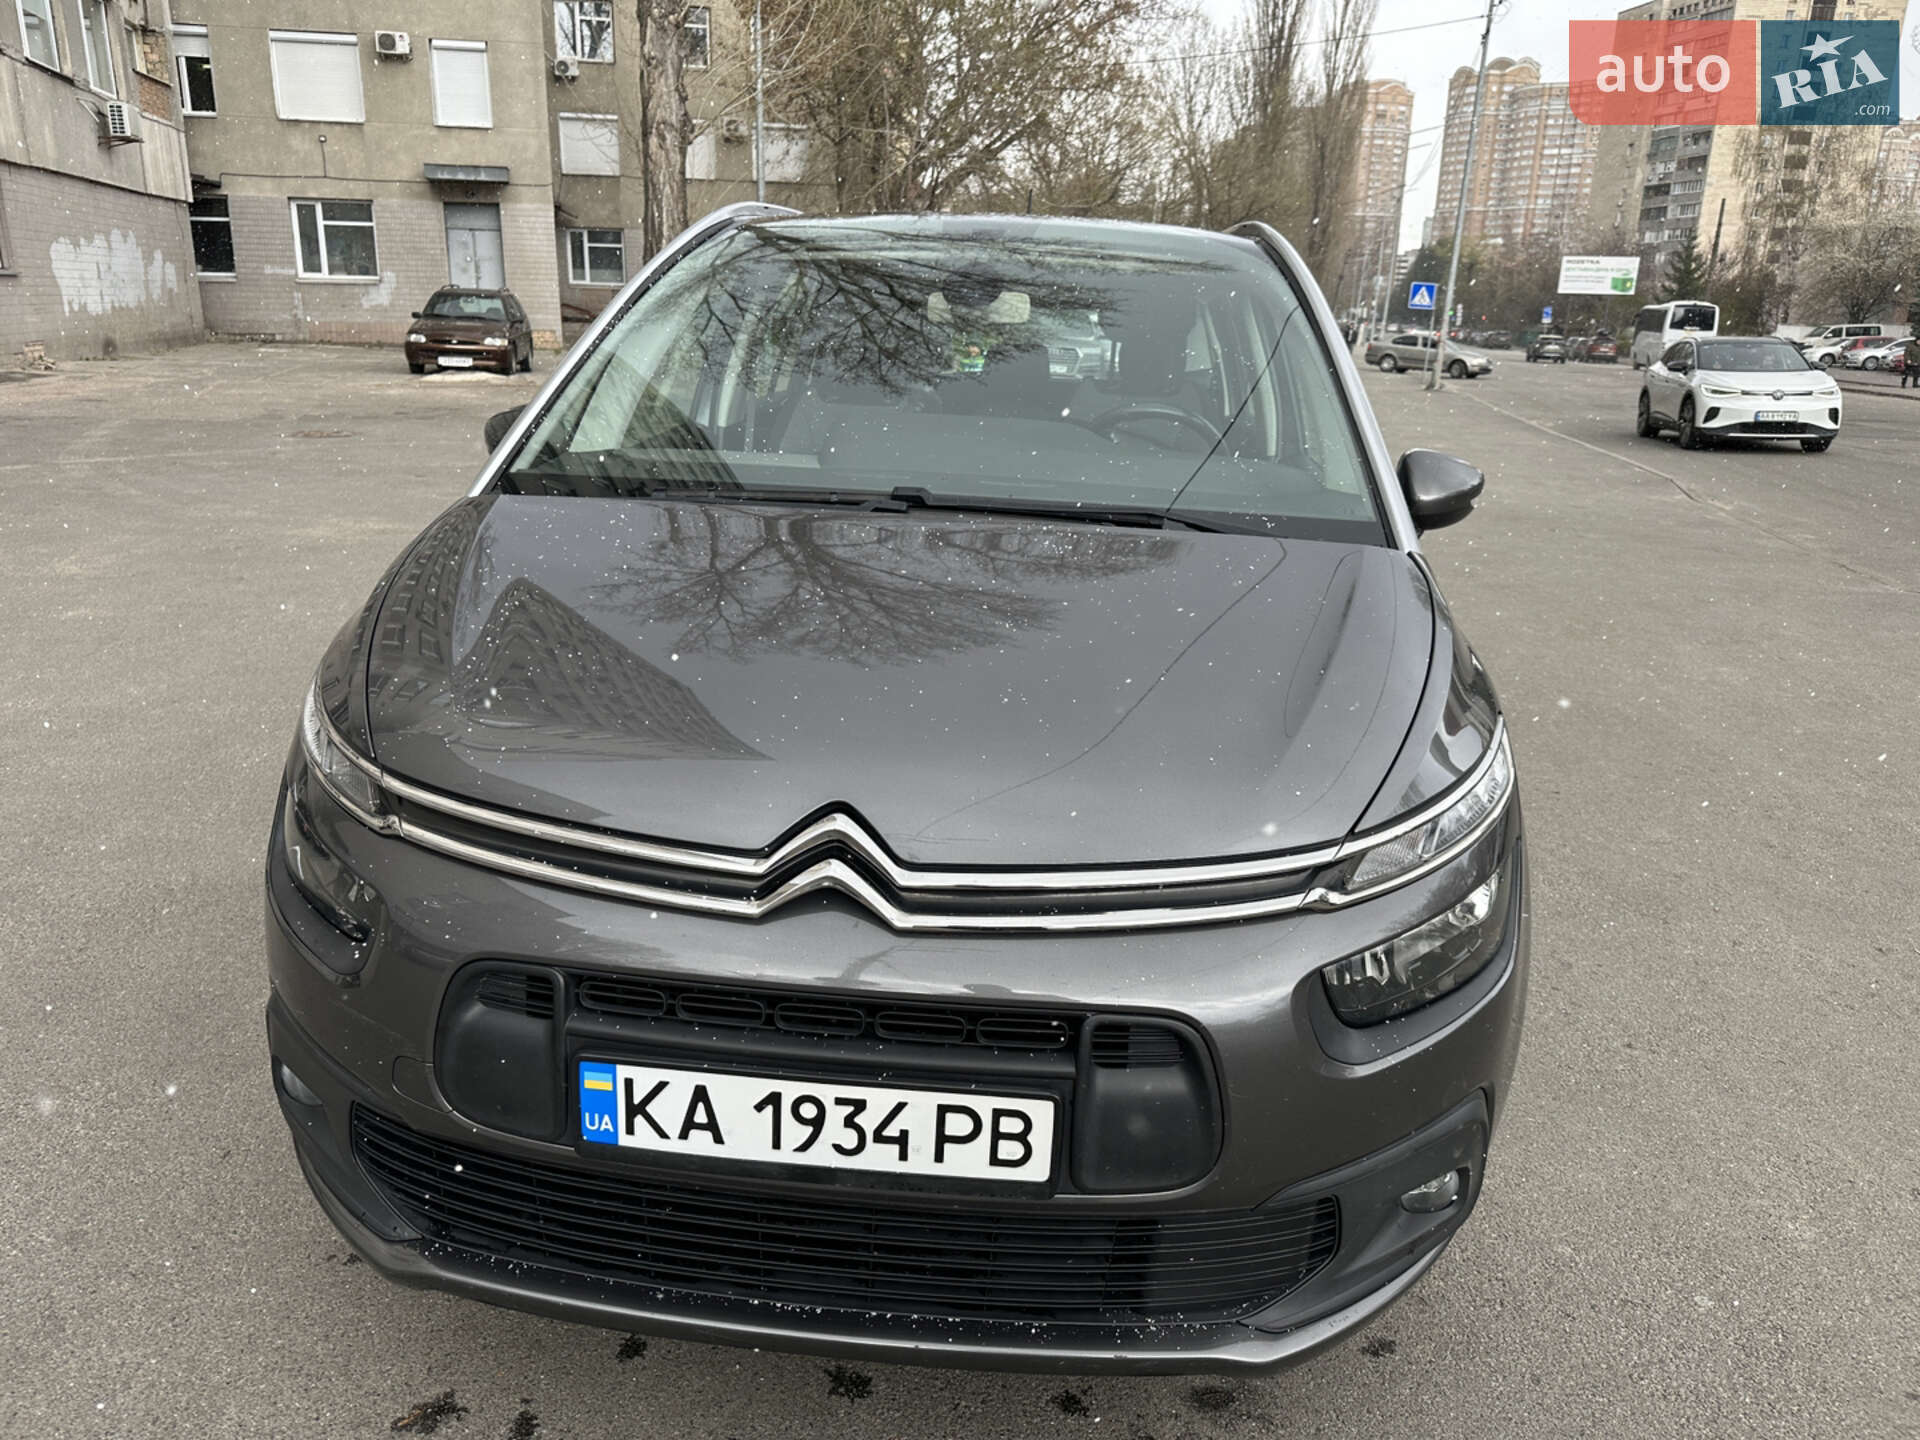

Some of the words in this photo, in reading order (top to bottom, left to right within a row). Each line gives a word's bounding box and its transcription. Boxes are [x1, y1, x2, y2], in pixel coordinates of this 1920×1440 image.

[584, 1112, 614, 1133] UA
[624, 1077, 725, 1145] KA
[753, 1091, 909, 1161] 1934
[934, 1103, 1034, 1168] PB
